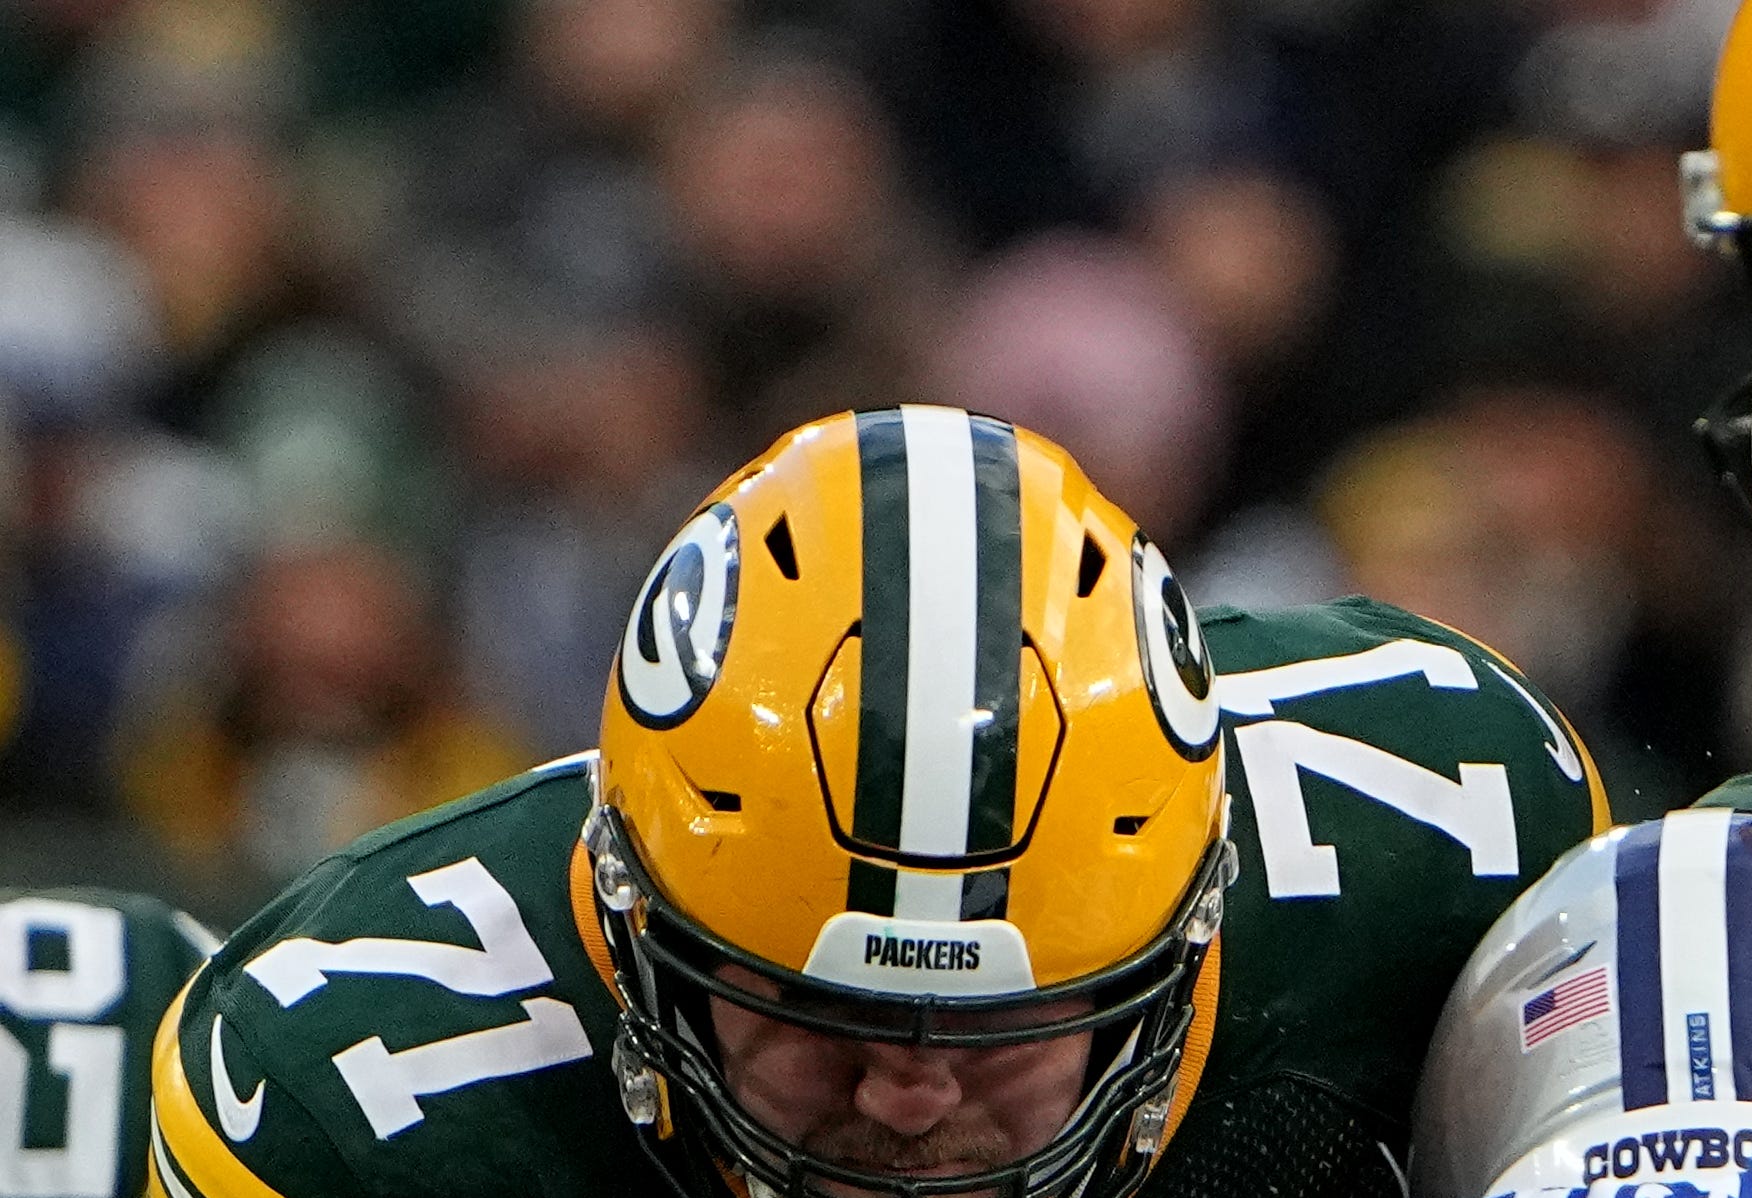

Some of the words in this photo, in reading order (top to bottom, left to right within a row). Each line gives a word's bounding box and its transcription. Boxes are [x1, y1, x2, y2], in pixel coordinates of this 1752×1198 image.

[1216, 637, 1521, 899] 71
[242, 856, 595, 1141] 71
[864, 933, 981, 970] PACKERS
[1689, 1014, 1713, 1097] ATKINS
